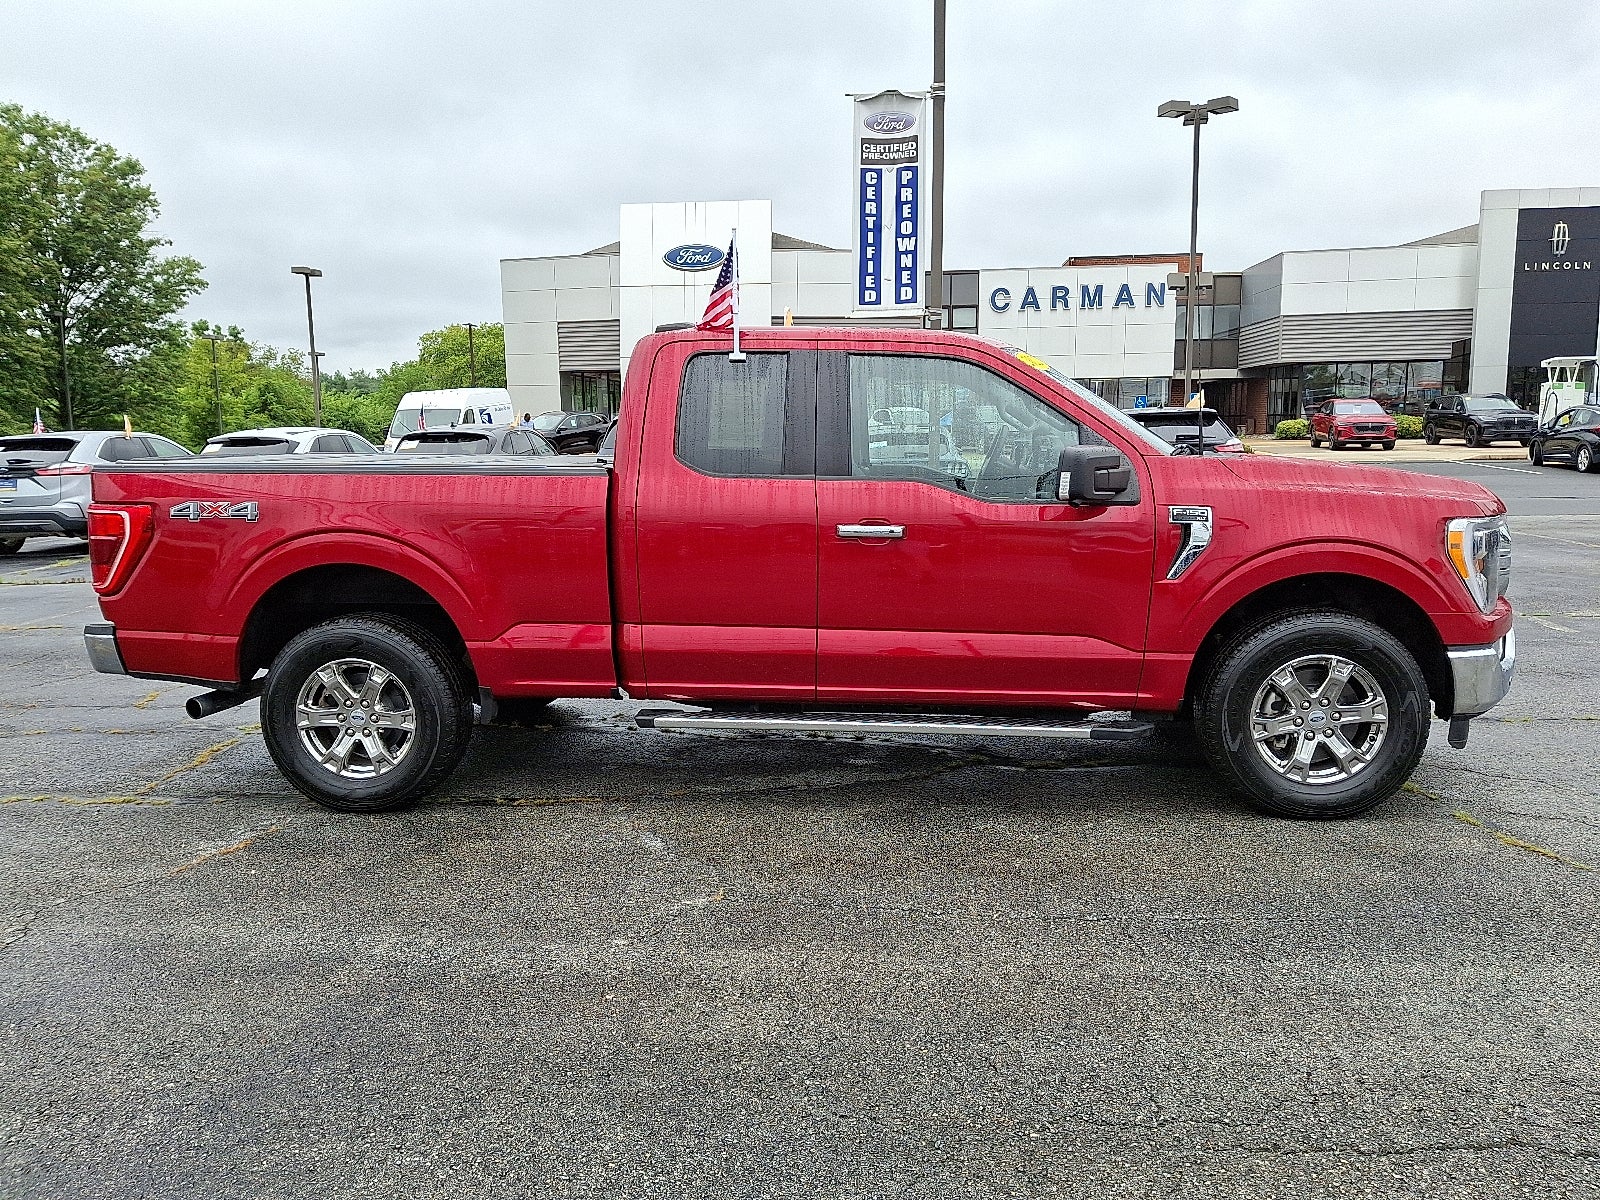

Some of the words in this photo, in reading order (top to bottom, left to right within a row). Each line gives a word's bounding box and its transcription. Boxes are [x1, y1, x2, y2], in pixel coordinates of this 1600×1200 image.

[873, 114, 906, 130] Ford
[862, 142, 917, 153] CERTIFIED
[862, 150, 917, 160] PRE-OWNED
[864, 171, 878, 303] CERTIFIED
[896, 170, 917, 301] PREOWNED
[676, 248, 713, 264] Ford
[1524, 261, 1592, 271] LINCOLN
[990, 282, 1166, 313] CARMAN
[1173, 508, 1208, 517] F-150
